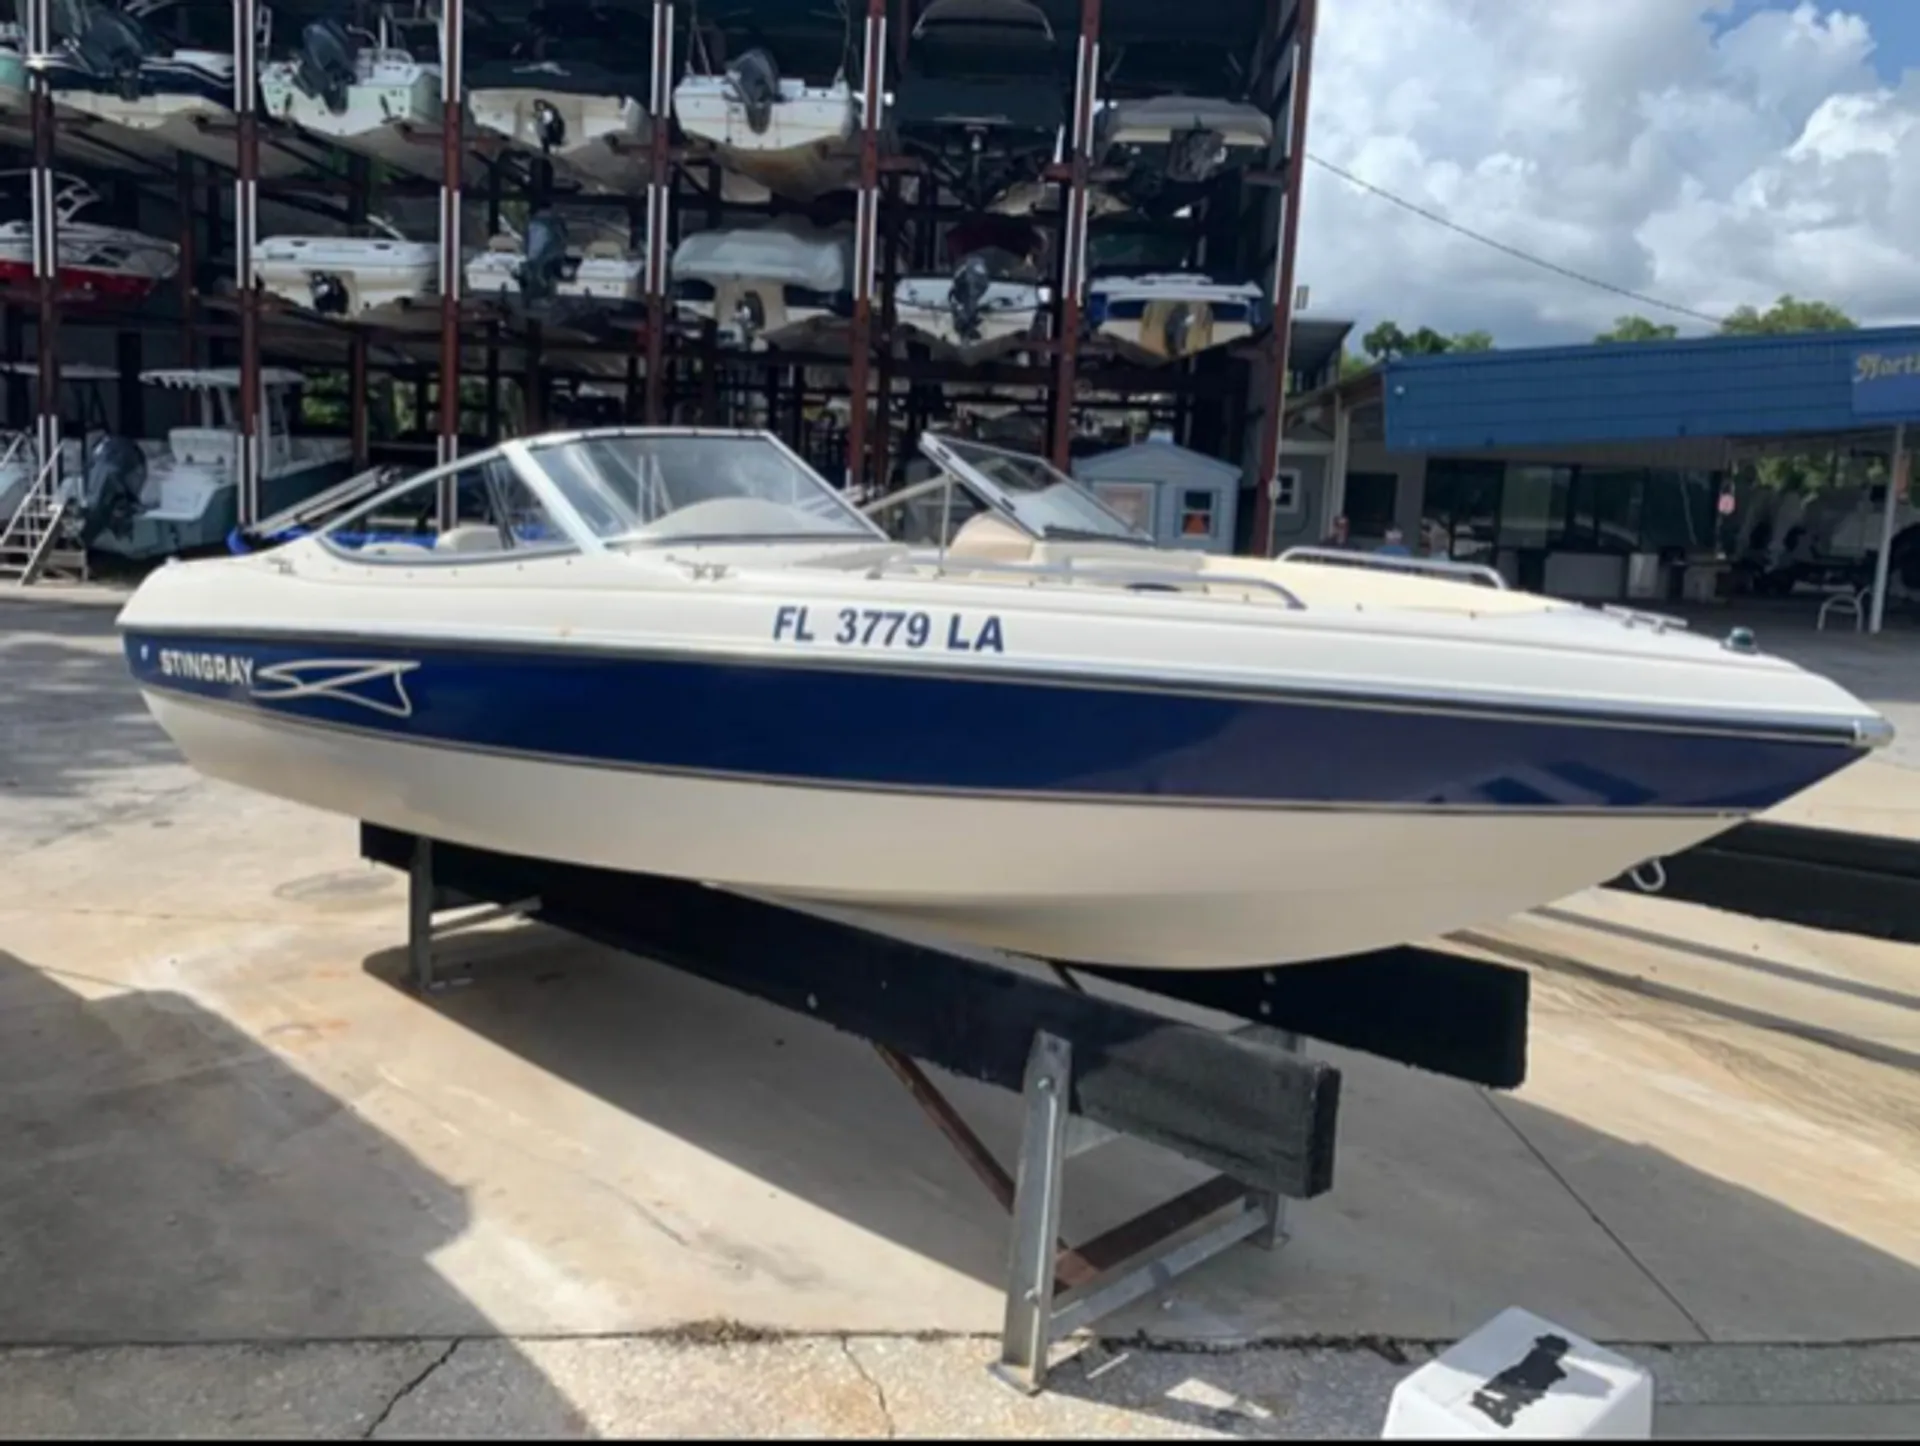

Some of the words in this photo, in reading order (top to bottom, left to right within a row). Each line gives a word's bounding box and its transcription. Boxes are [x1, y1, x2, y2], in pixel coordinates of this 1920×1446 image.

[773, 605, 814, 642] FL
[836, 608, 931, 648] 3779
[946, 613, 1005, 652] LA
[159, 650, 254, 685] STINGRAY
